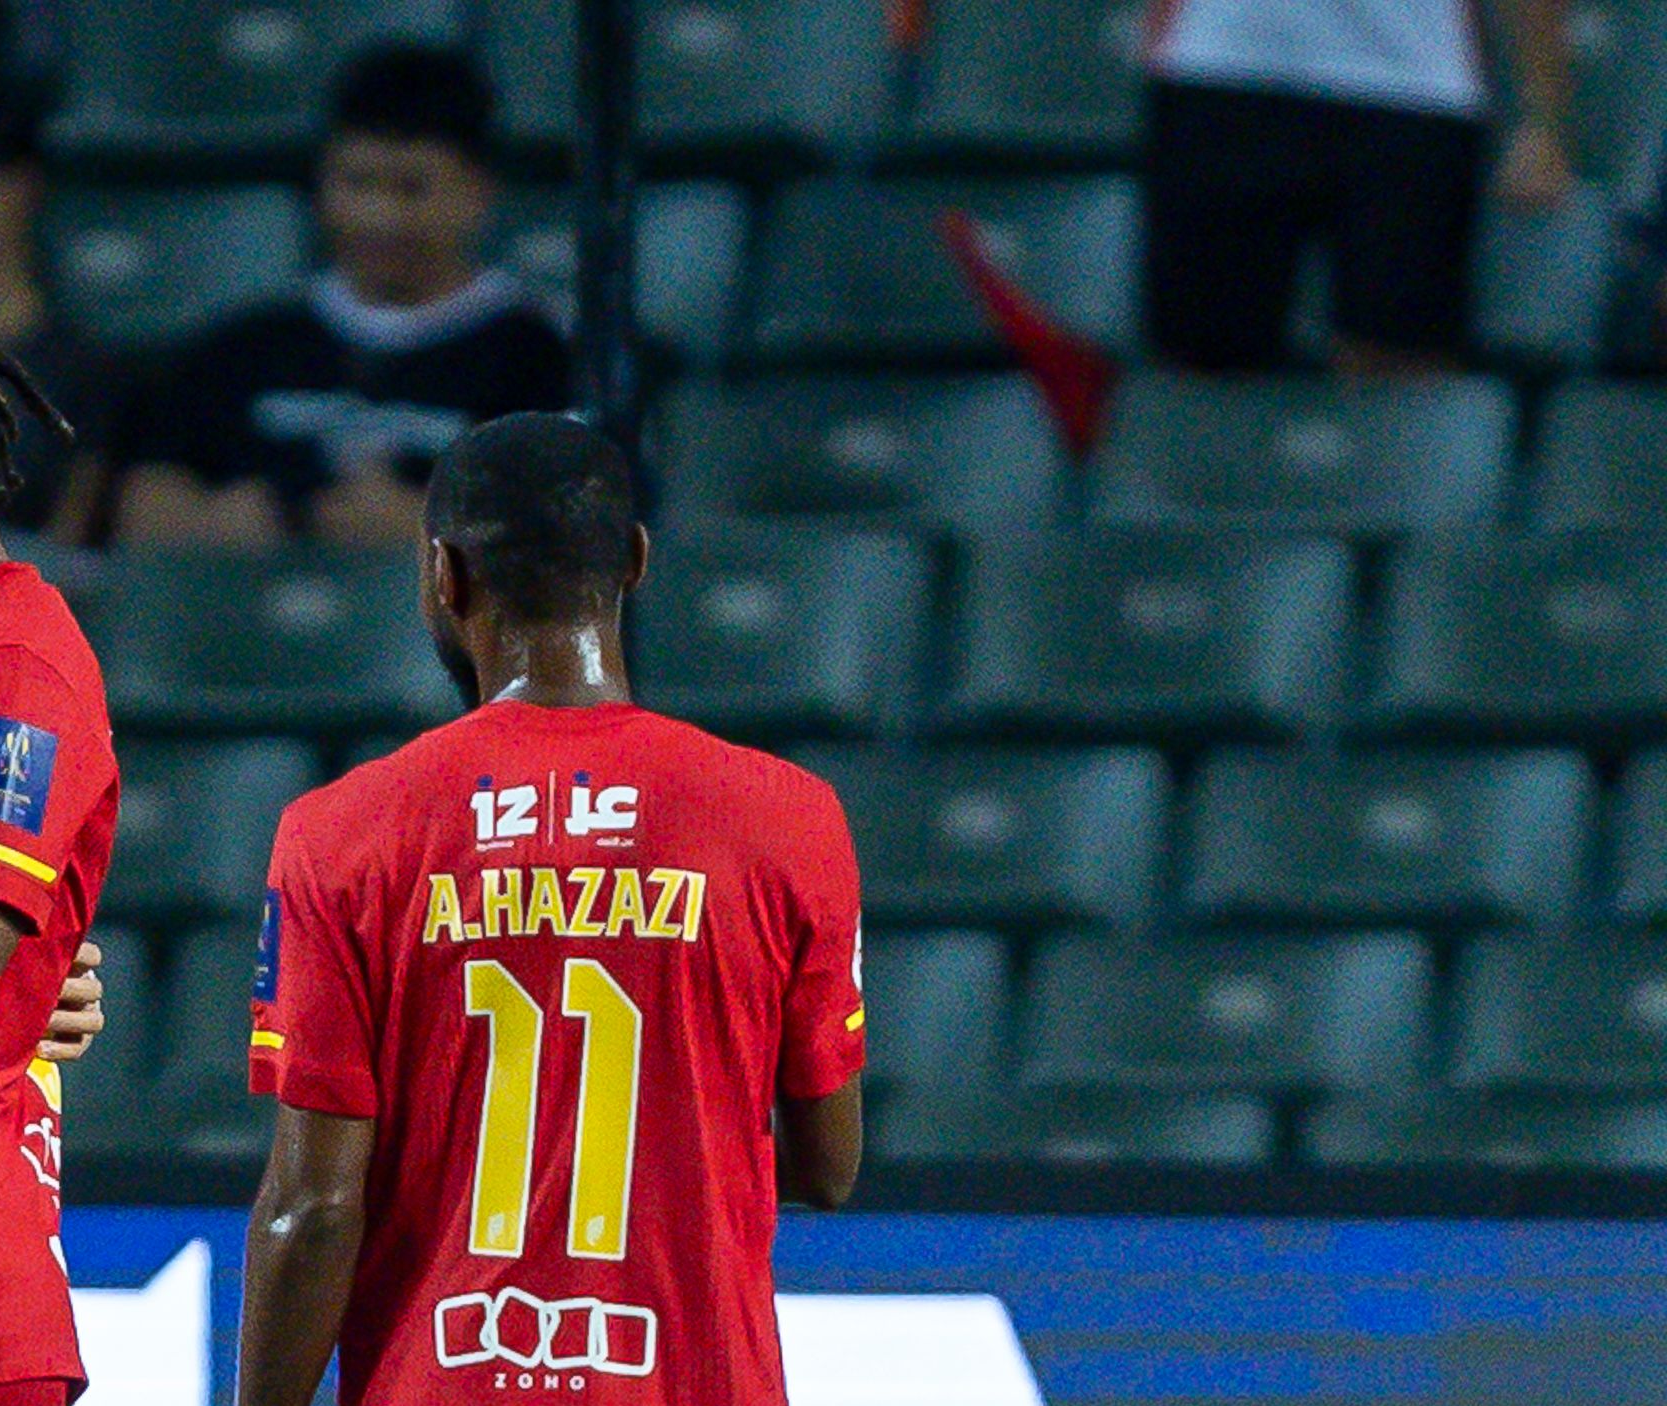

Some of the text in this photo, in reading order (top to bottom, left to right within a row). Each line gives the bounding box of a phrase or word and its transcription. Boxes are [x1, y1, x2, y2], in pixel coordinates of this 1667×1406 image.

[422, 867, 708, 944] A.HAZAZI
[463, 957, 644, 1261] 11
[493, 1372, 587, 1392] ZOHO
